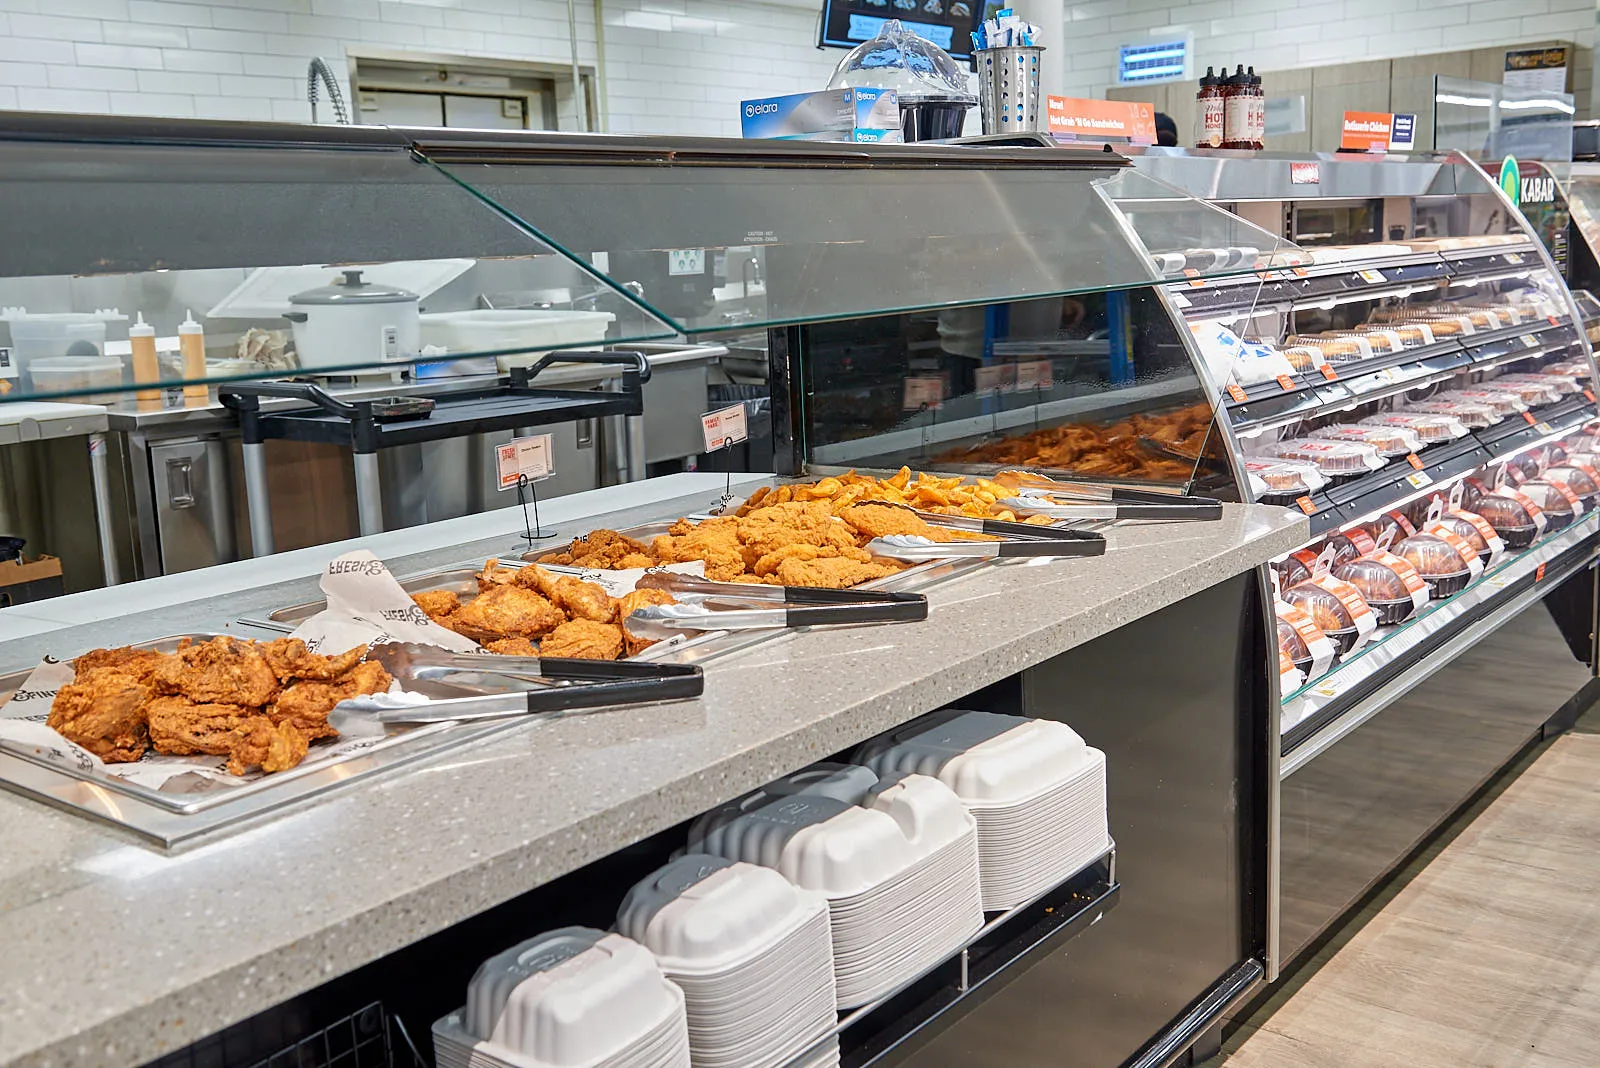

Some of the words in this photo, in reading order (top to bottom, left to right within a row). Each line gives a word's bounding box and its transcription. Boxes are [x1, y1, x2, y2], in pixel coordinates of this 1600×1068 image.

[861, 91, 876, 100] elara
[755, 103, 778, 115] elara
[1061, 116, 1075, 127] Grab
[1082, 118, 1091, 128] Go
[1205, 113, 1224, 123] HOT
[1521, 177, 1555, 203] KABAR
